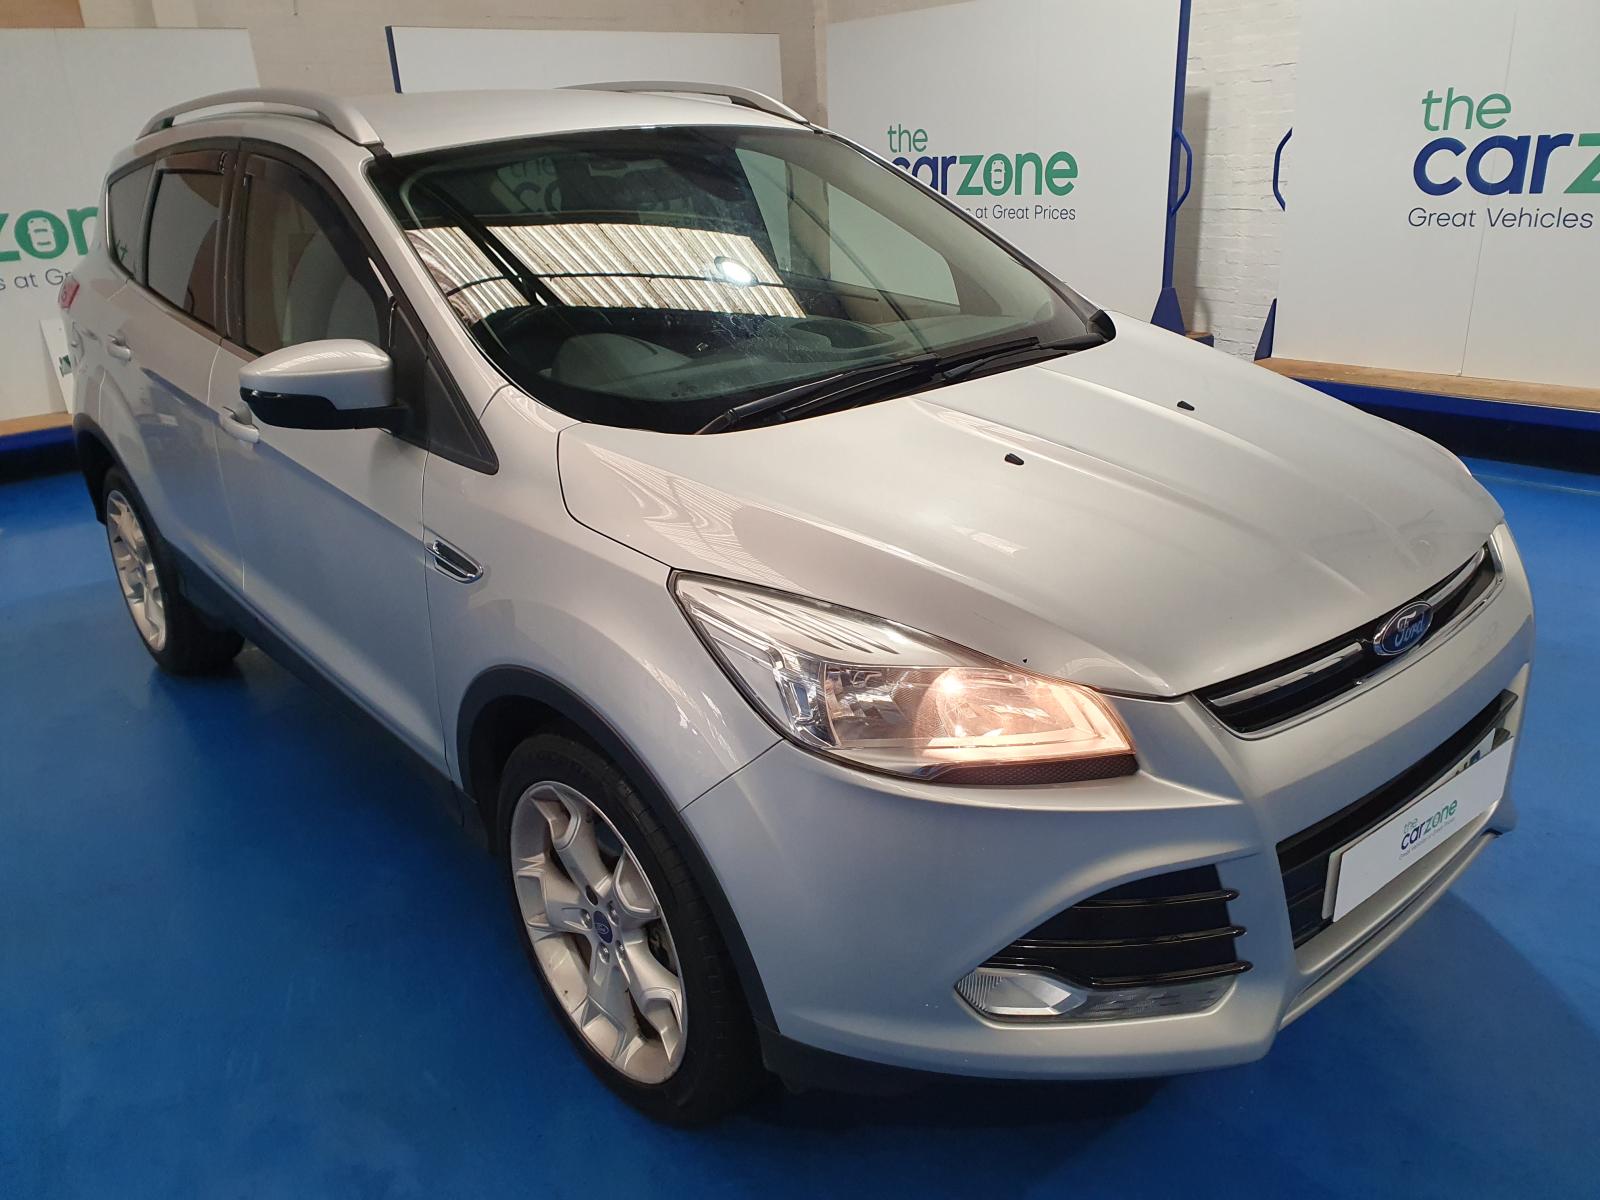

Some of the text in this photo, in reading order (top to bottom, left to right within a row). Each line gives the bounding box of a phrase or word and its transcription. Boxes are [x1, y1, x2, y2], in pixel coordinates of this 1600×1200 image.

[1421, 87, 1512, 131] the
[887, 123, 929, 153] the
[976, 204, 1076, 220] at Great Prices
[1408, 206, 1594, 229] Great Vehicles
[14, 272, 38, 289] at
[1395, 610, 1426, 648] Ford
[1401, 799, 1458, 851] carzone
